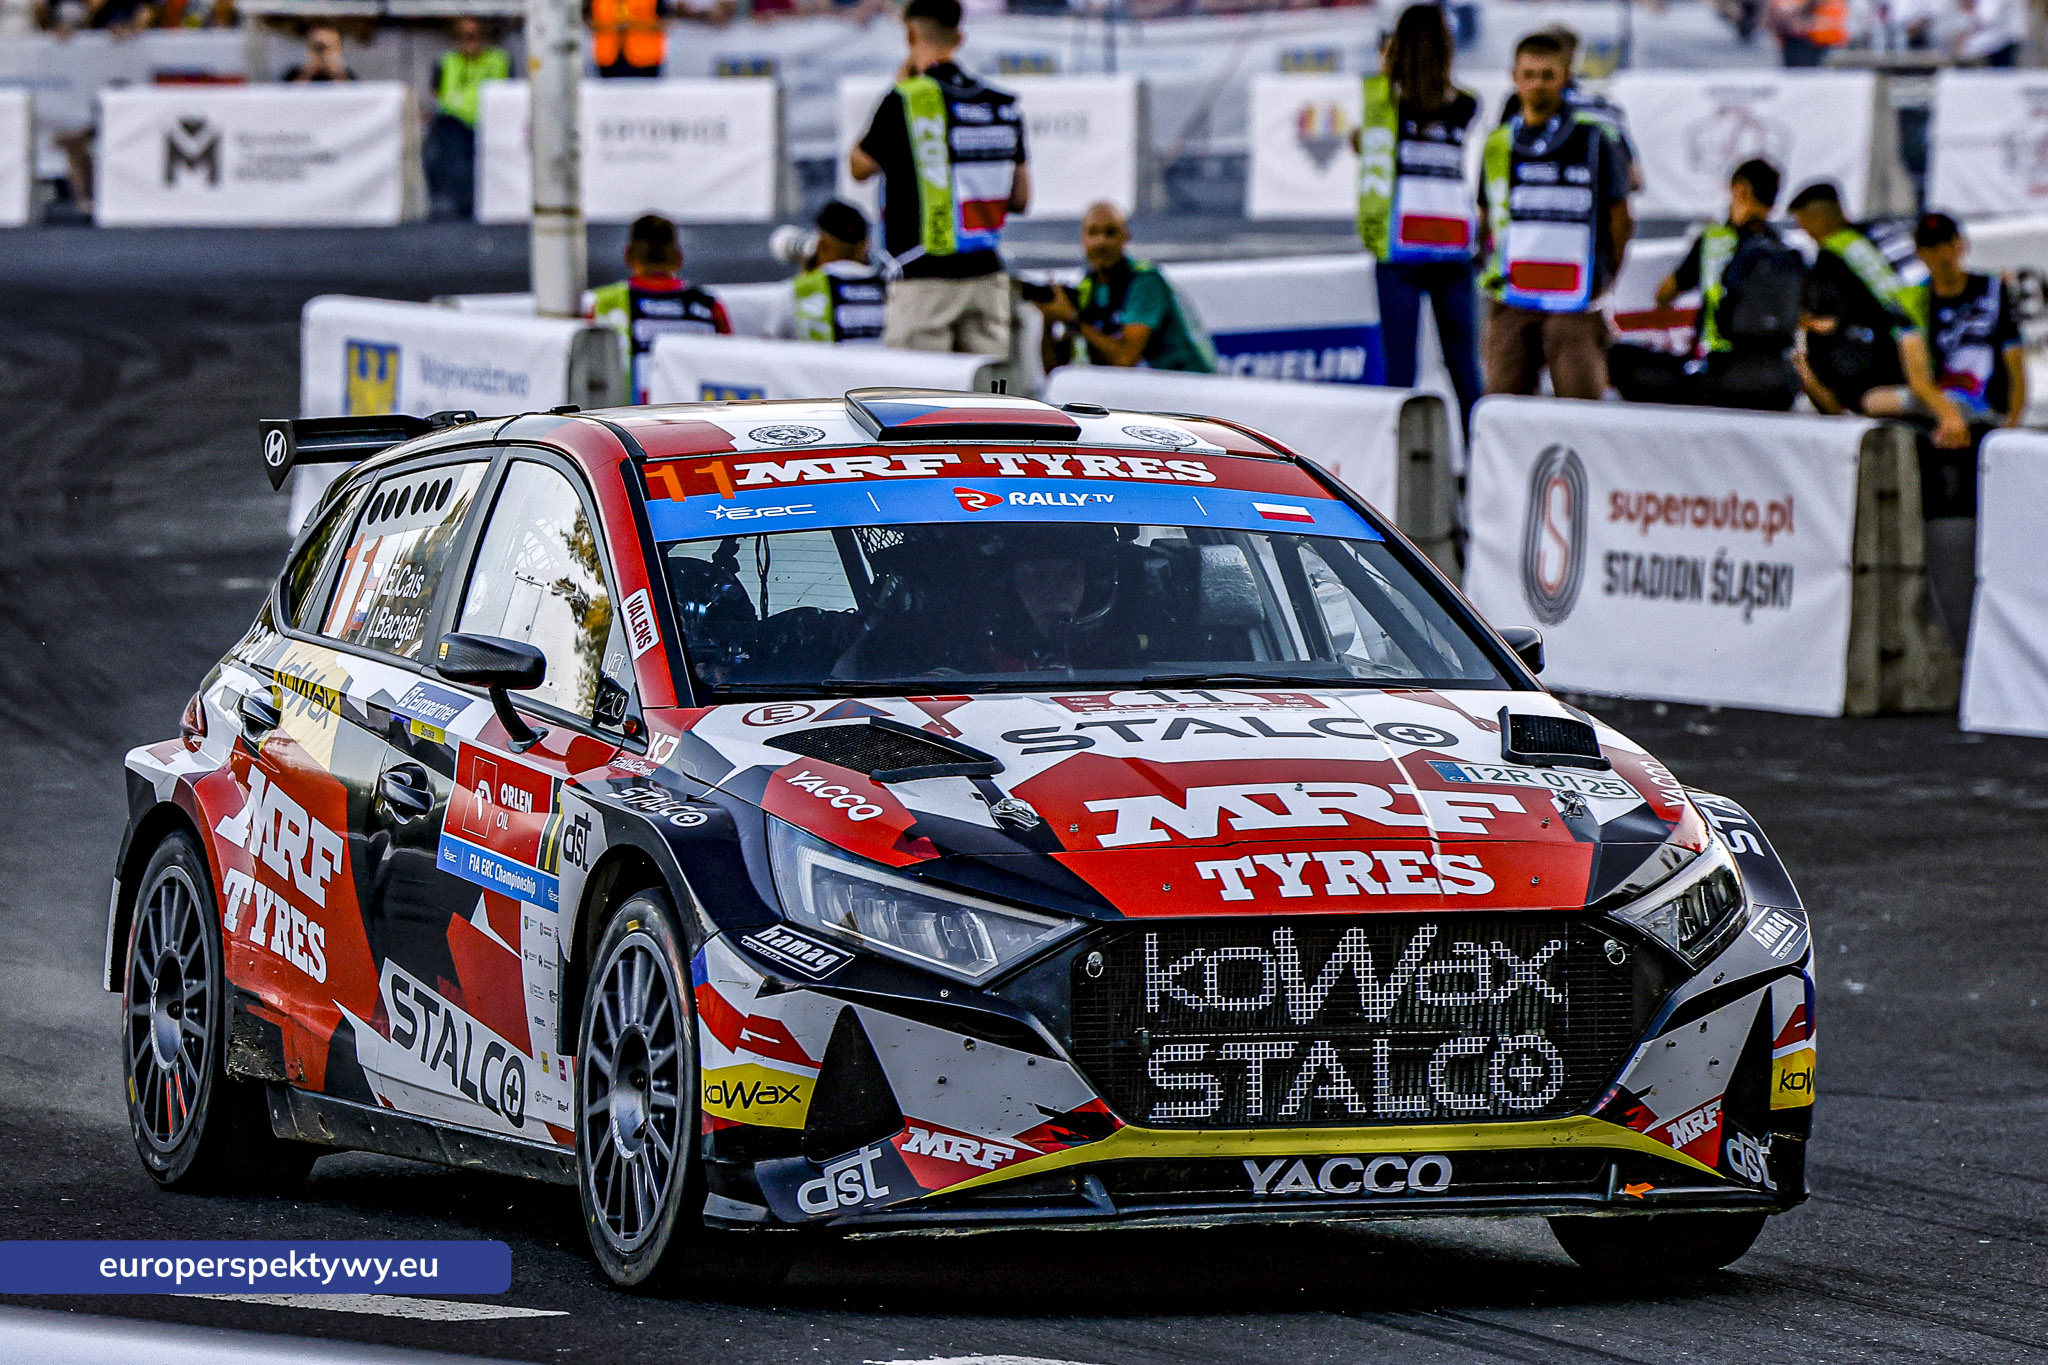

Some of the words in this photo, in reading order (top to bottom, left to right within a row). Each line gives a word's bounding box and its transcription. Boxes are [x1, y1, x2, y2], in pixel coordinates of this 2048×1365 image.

[645, 460, 736, 503] 11
[733, 453, 961, 487] MRF
[979, 452, 1217, 483] TYRES
[1609, 489, 1794, 546] superauto.pl
[1605, 549, 1705, 602] STADION
[1711, 545, 1794, 625] ŚLĄSKI
[627, 594, 652, 650] VALENS
[1135, 690, 1224, 703] 11
[1000, 715, 1459, 755] STALCO
[500, 782, 533, 815] ORLEN
[785, 769, 885, 822] YACCO
[1463, 765, 1537, 785] 12R
[1638, 759, 1687, 808] YACCO
[496, 811, 510, 831] OIL
[606, 786, 709, 828] STALCO
[1083, 781, 1529, 849] MRF
[214, 763, 345, 909] MRF
[563, 812, 592, 873] dst
[468, 853, 481, 874] FIA
[481, 858, 495, 878] ERC
[494, 863, 537, 899] Championship
[1193, 849, 1496, 902] TYRES
[222, 867, 328, 985] TYRES
[753, 927, 840, 967] hamag
[390, 973, 526, 1129] STALCO
[704, 1079, 802, 1110] koWax
[1147, 1034, 1565, 1120] STALCO
[900, 1125, 1016, 1170] MRF
[1665, 1099, 1722, 1150] MRF
[796, 1145, 890, 1214] dst
[1242, 1154, 1453, 1196] YACCO
[1726, 1132, 1778, 1191] dst
